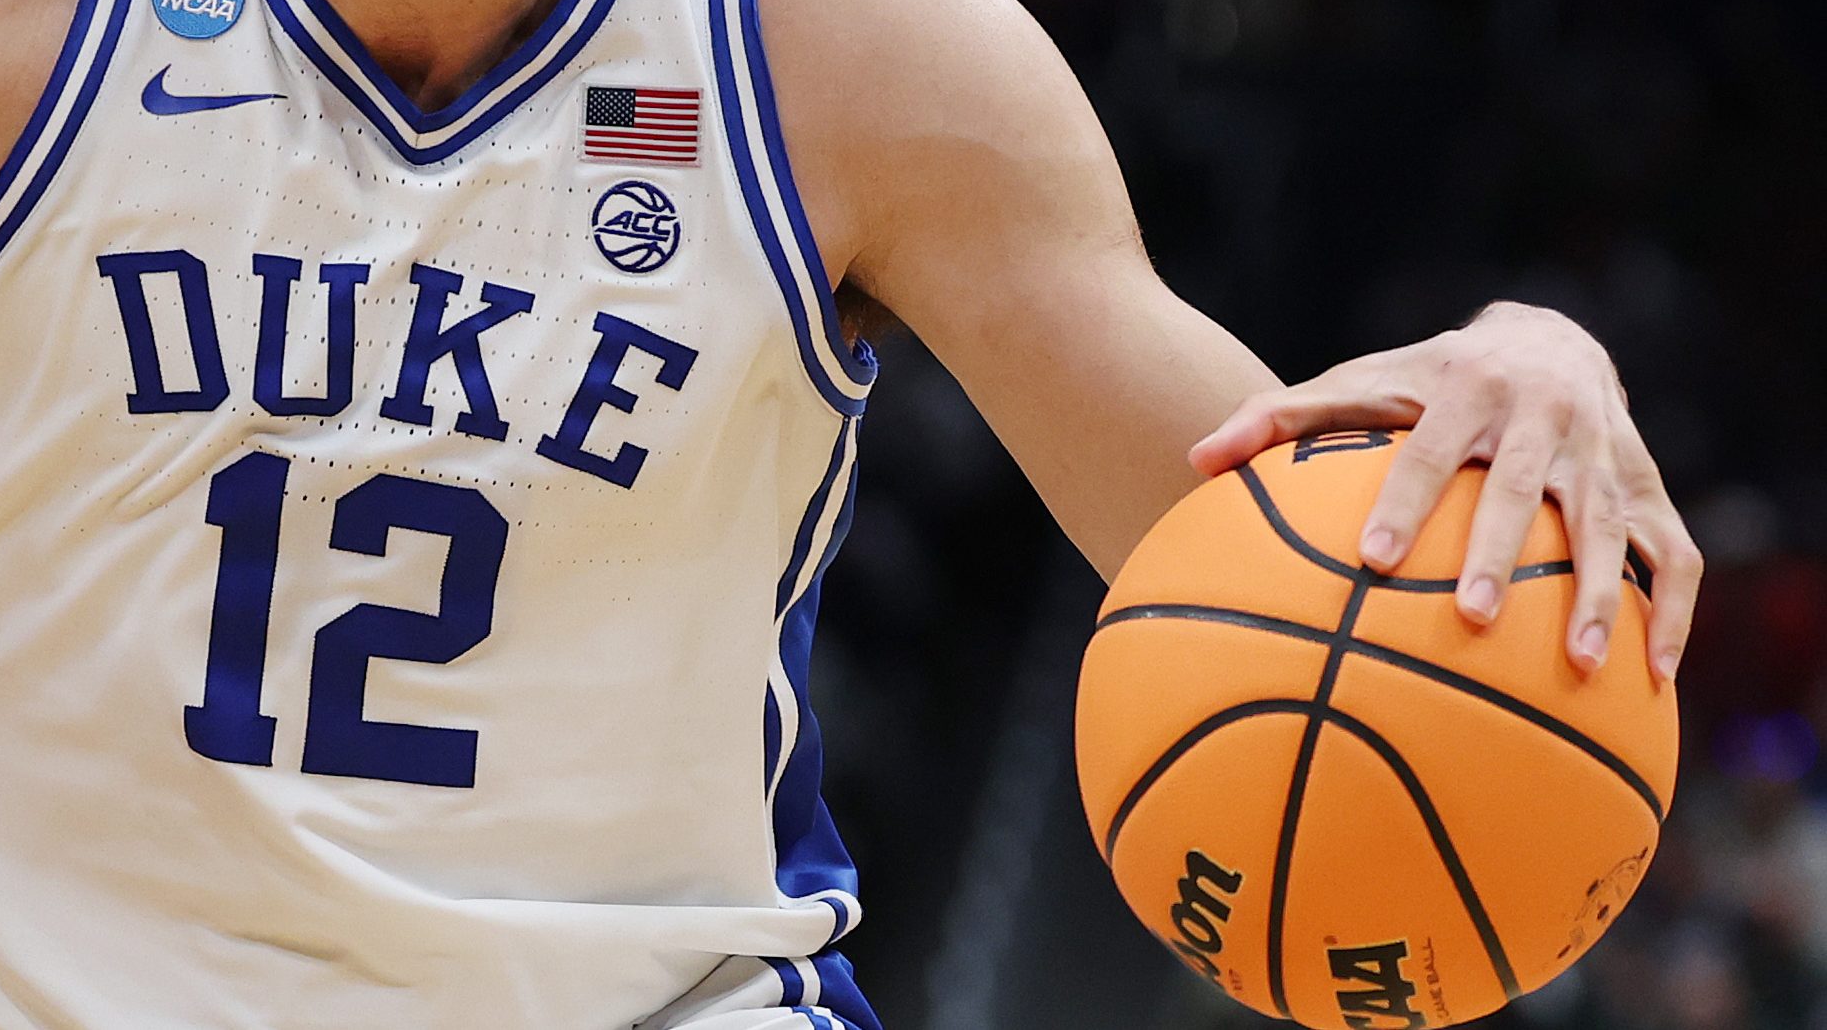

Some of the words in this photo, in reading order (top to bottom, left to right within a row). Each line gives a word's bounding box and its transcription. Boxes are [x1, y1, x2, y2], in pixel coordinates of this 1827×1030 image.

[604, 210, 677, 236] ACC
[96, 249, 699, 490] DUKE
[184, 451, 509, 788] 12
